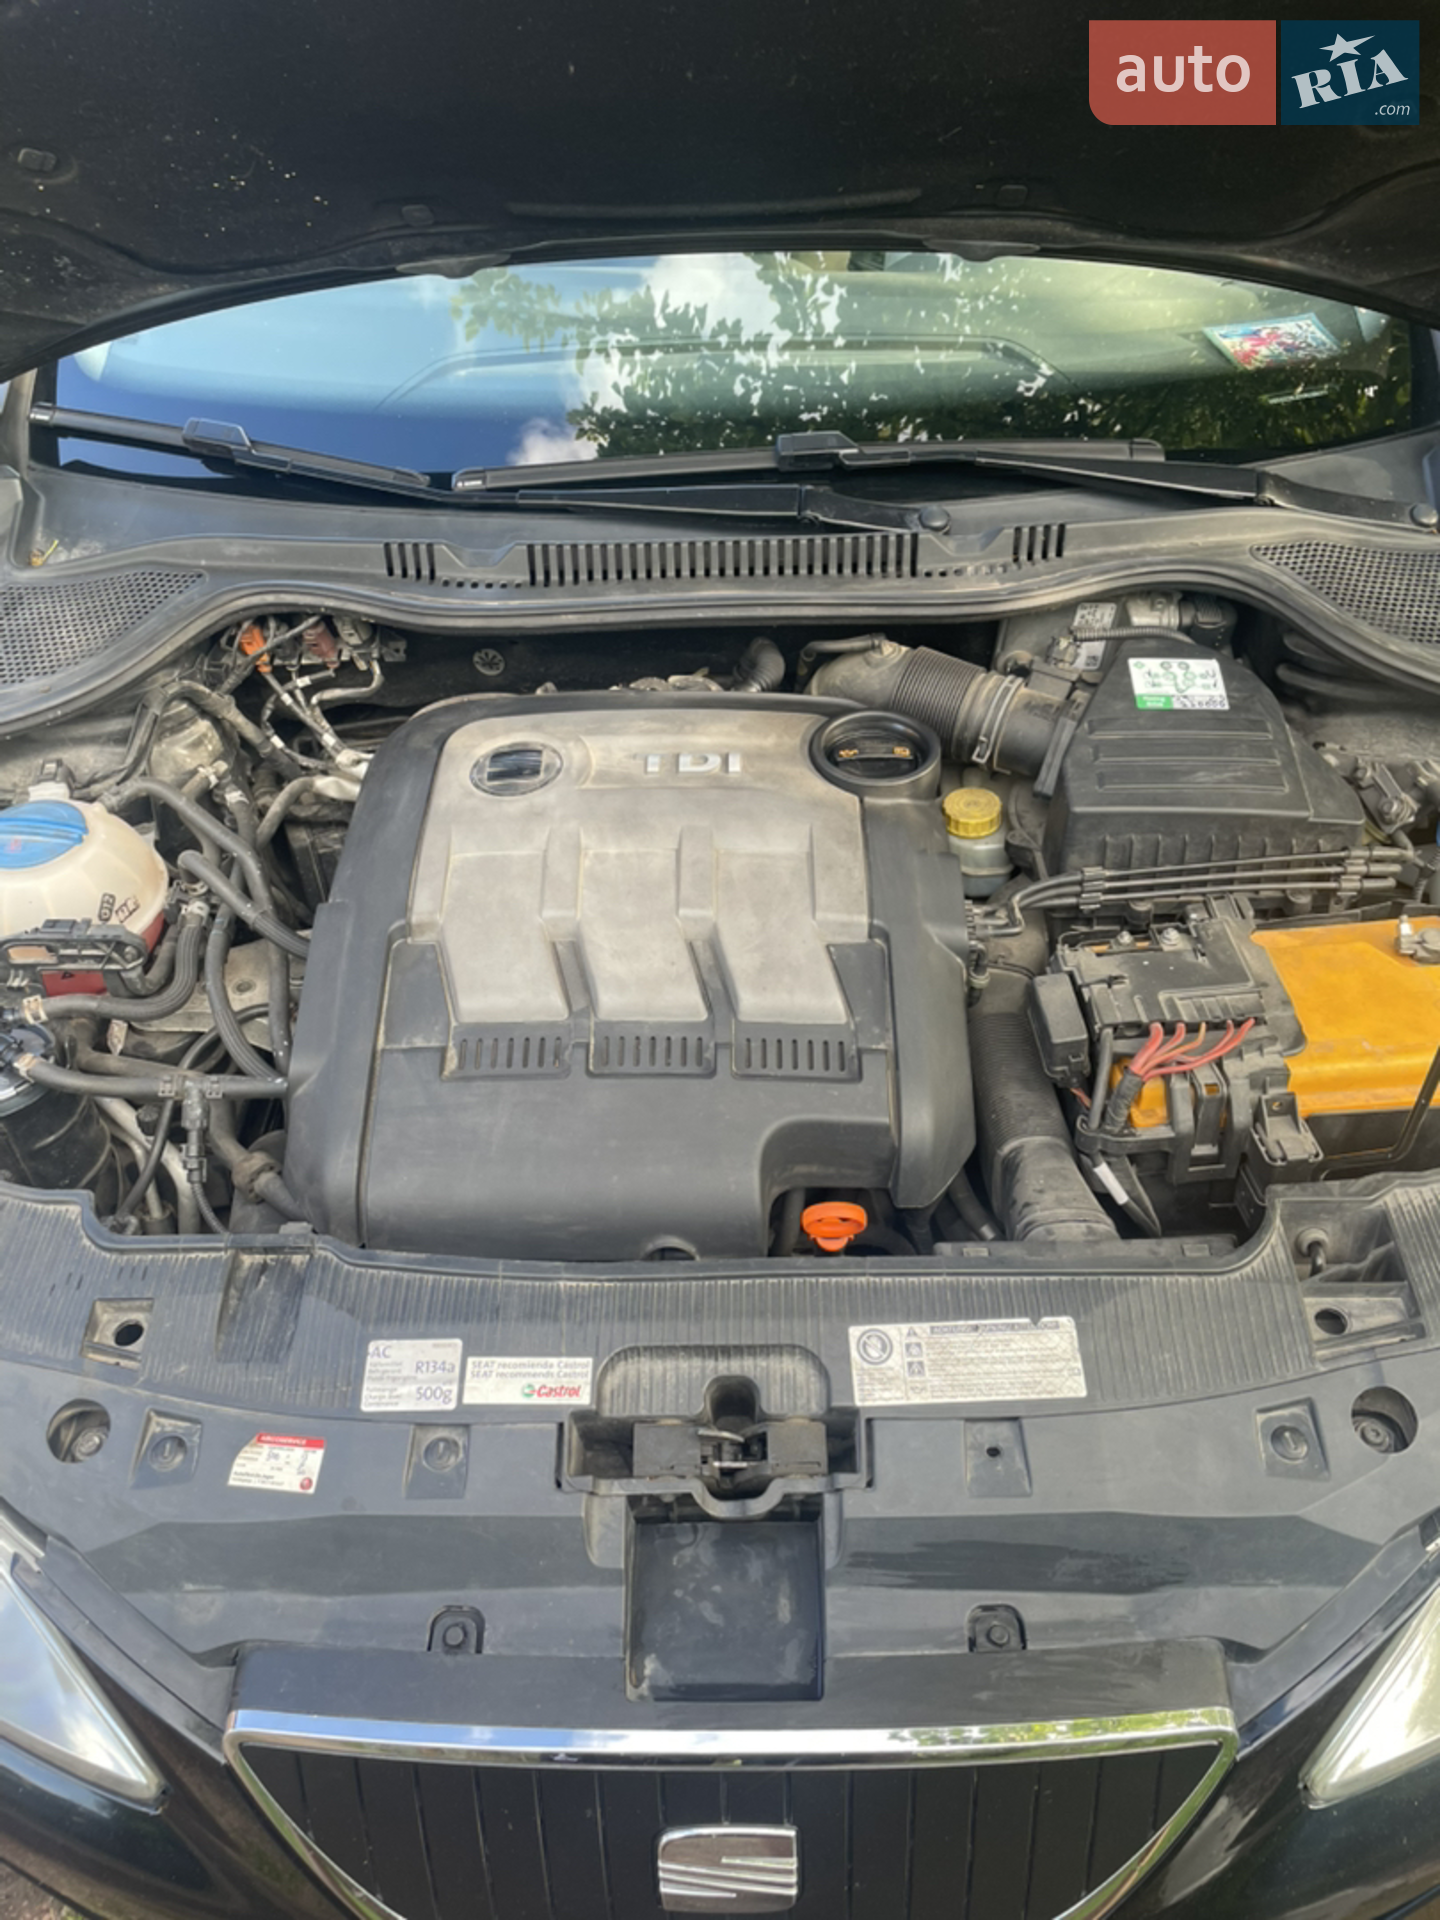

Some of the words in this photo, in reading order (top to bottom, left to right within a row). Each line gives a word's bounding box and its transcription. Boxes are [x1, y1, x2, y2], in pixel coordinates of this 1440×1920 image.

[370, 1345, 392, 1358] AC
[415, 1360, 455, 1373] R134a
[472, 1361, 495, 1369] SEAT
[470, 1370, 493, 1379] SEAT
[415, 1386, 453, 1404] 500g
[537, 1384, 581, 1398] Castrol
